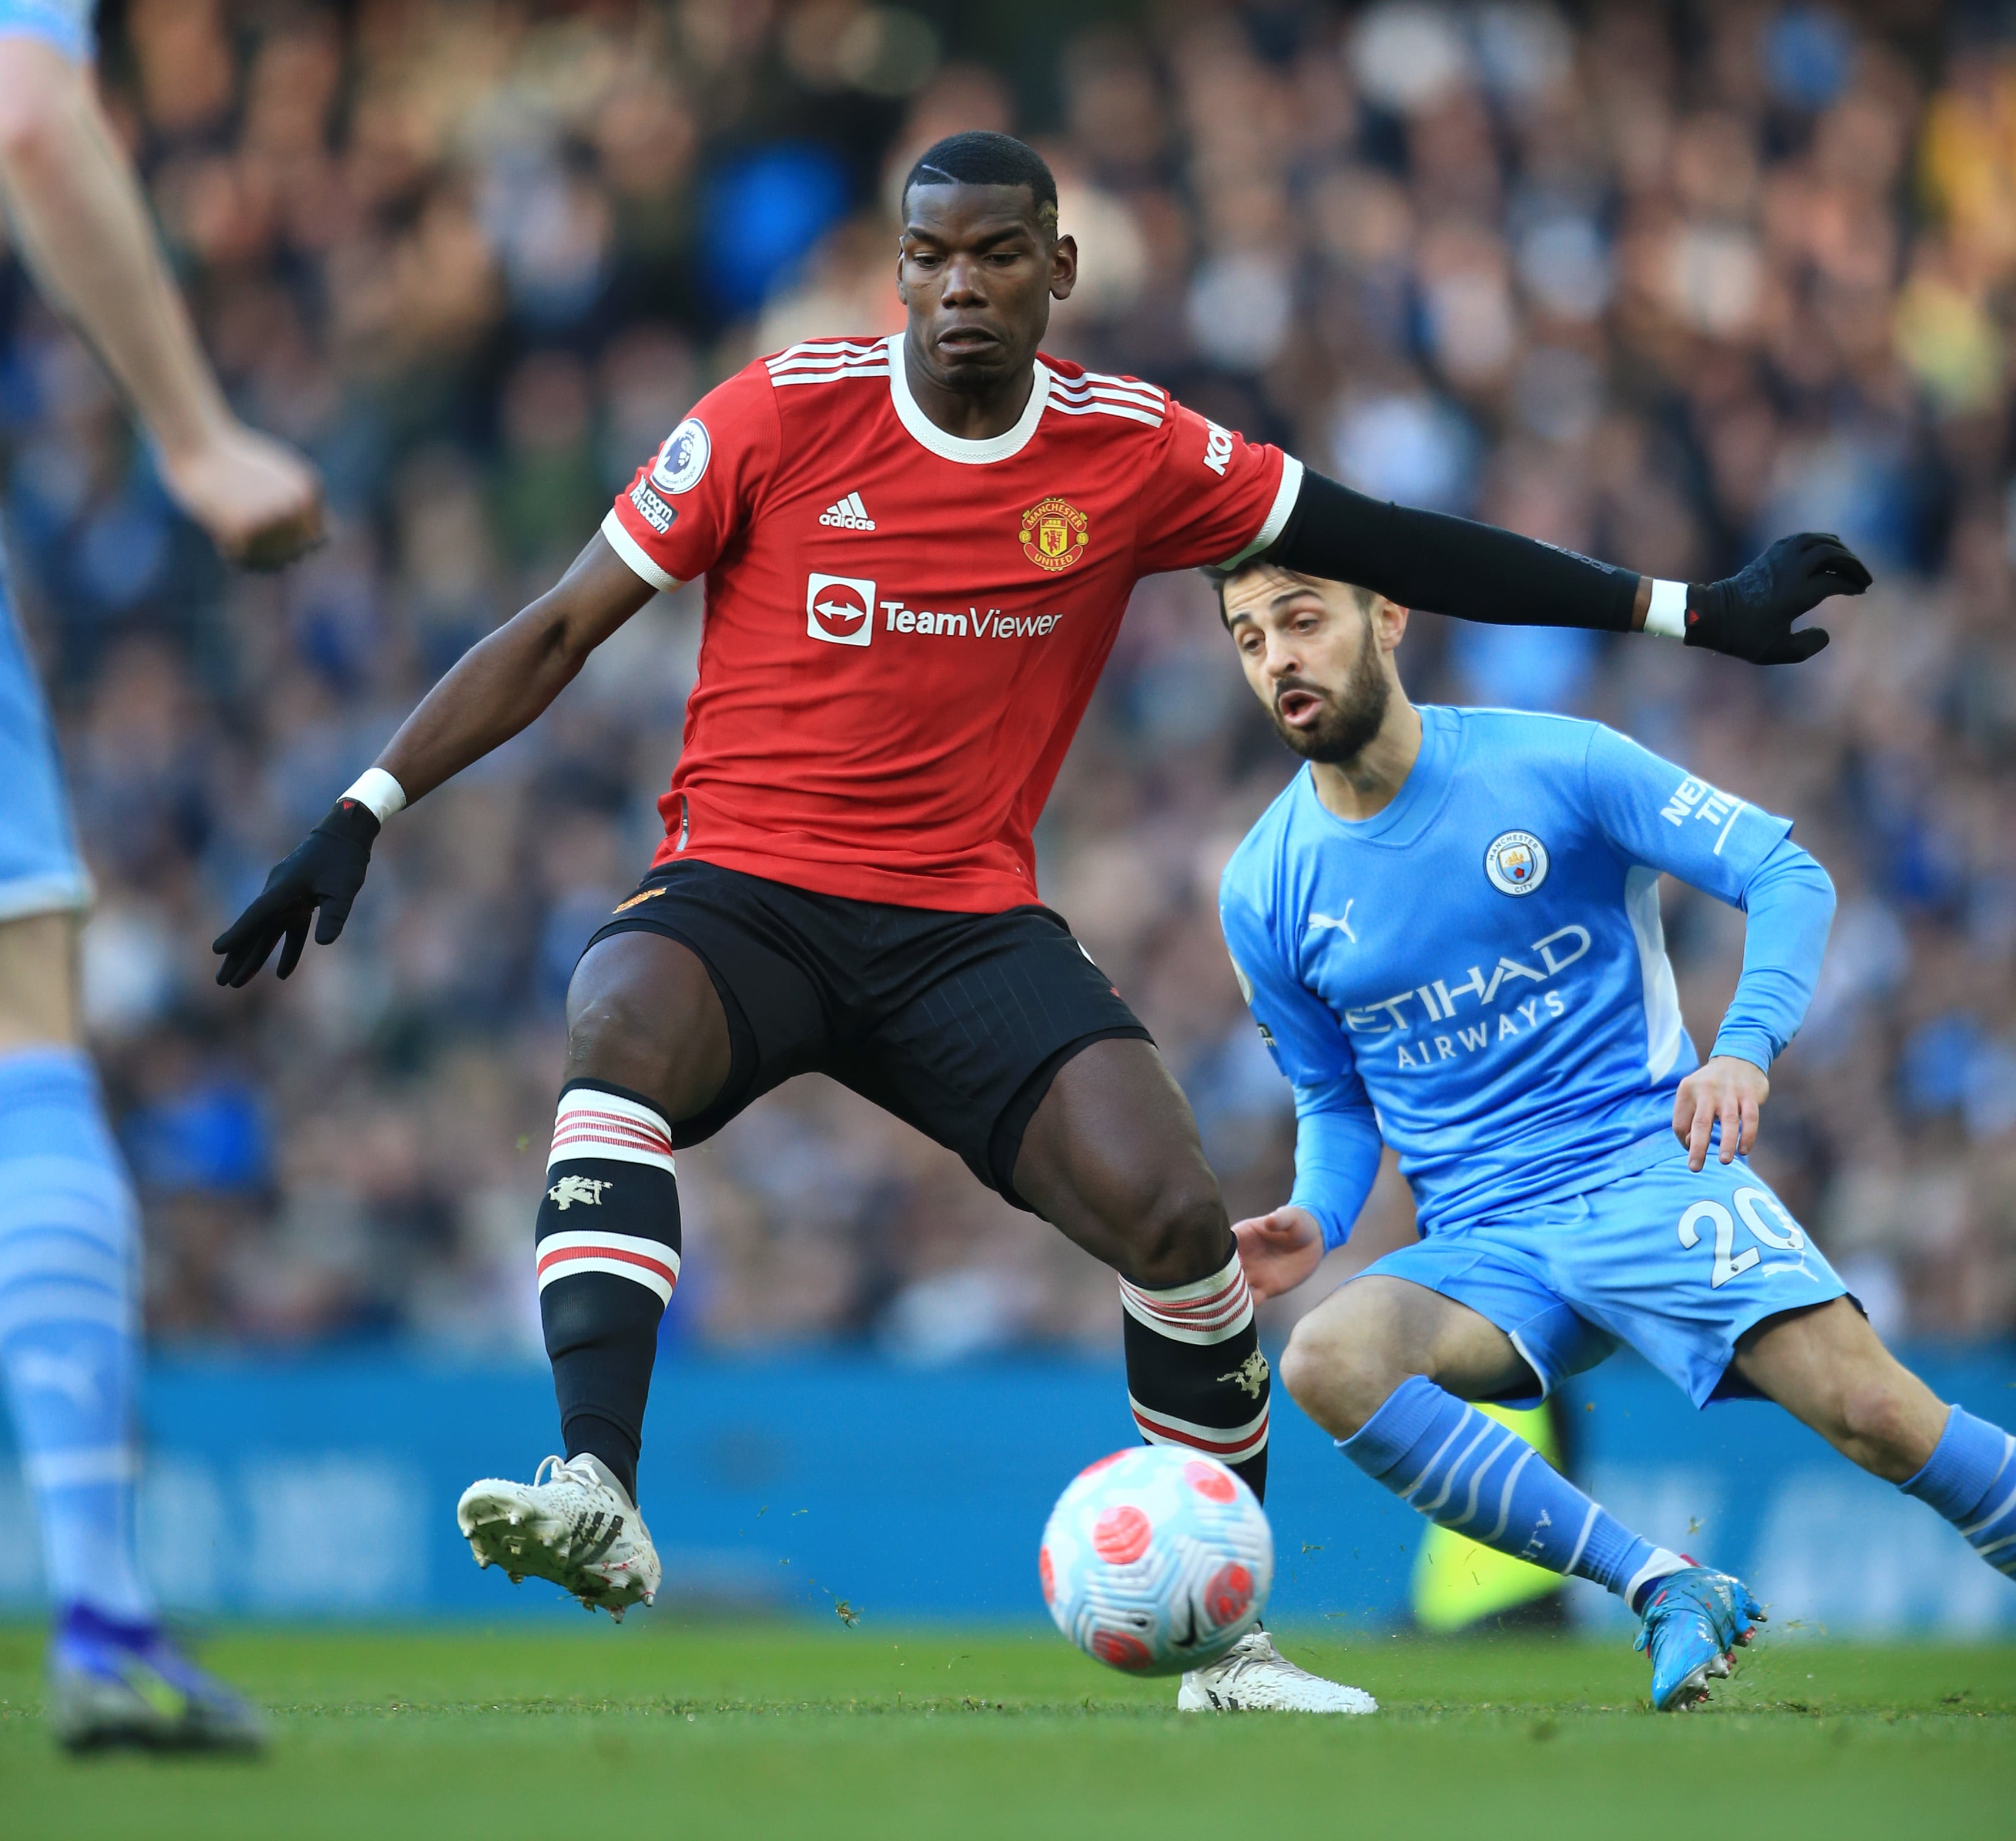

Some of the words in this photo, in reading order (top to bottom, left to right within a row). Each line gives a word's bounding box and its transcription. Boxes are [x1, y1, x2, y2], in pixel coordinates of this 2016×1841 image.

[637, 499, 669, 535] racism
[642, 488, 673, 521] room
[1026, 504, 1083, 528] MANCHESTER
[819, 514, 876, 531] adidas
[1034, 553, 1073, 567] UNITED
[880, 601, 1063, 639] TeamViewer
[1489, 835, 1539, 861] MANCHESTER
[1514, 883, 1533, 893] CITY
[1344, 925, 1591, 1033] ETIHAD
[1398, 990, 1565, 1069] AIRWAYS
[1677, 1186, 1804, 1290] 20
